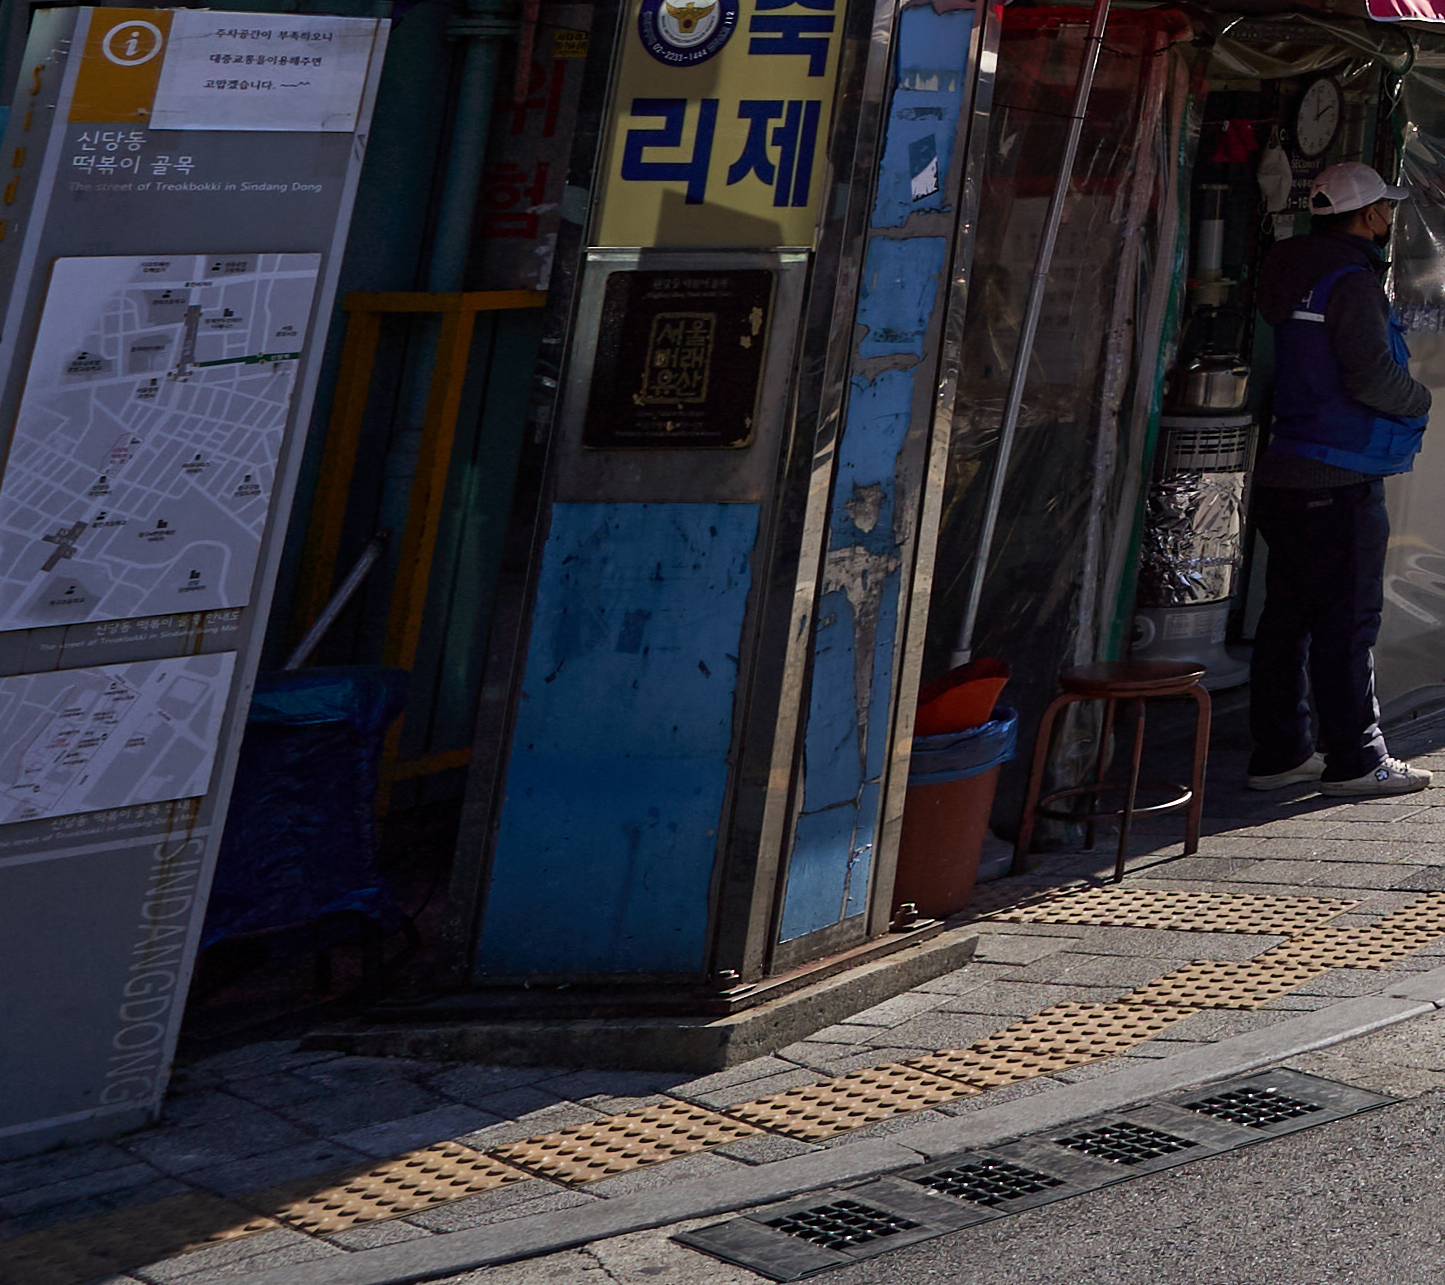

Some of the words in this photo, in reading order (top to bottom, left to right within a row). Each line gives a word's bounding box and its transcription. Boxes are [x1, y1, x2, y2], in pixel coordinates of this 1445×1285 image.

[77, 130, 147, 152] 신당동
[72, 154, 141, 175] 떡볶이
[150, 155, 196, 175] 골목
[101, 837, 207, 1107] SINDANGDONG
